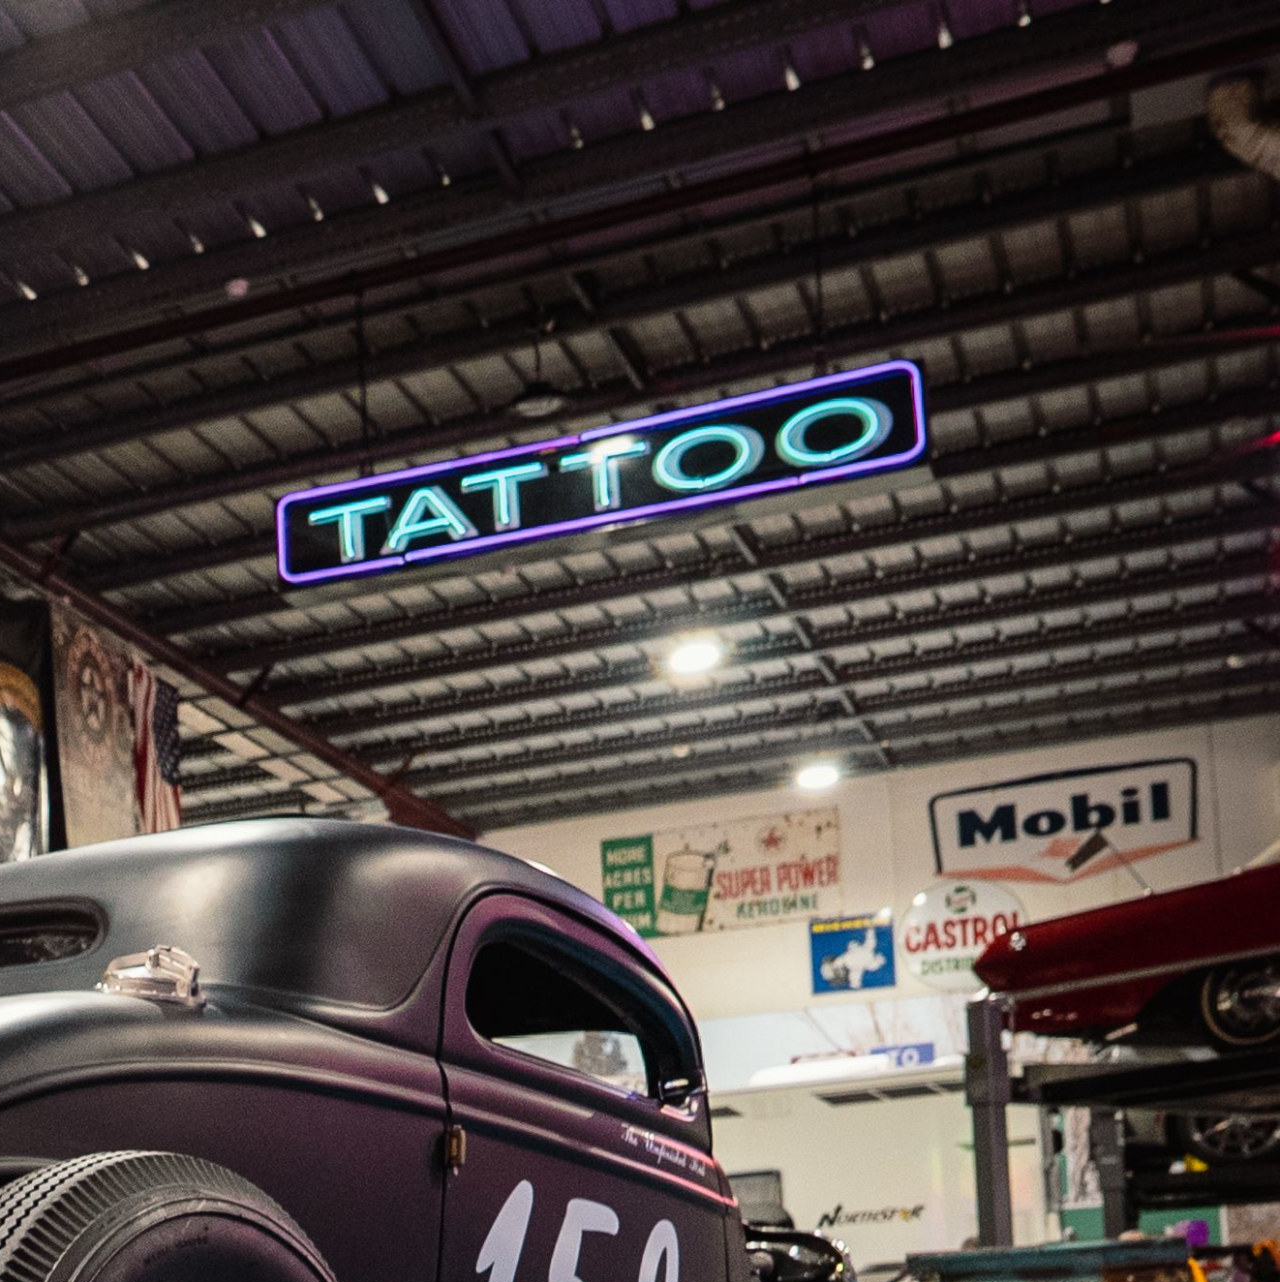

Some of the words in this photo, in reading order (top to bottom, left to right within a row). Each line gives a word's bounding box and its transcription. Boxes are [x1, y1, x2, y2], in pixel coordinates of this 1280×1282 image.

[307, 396, 894, 563] TATTOO
[958, 781, 1170, 848] Mobil
[715, 866, 772, 900] SUPER
[777, 853, 839, 891] POWER
